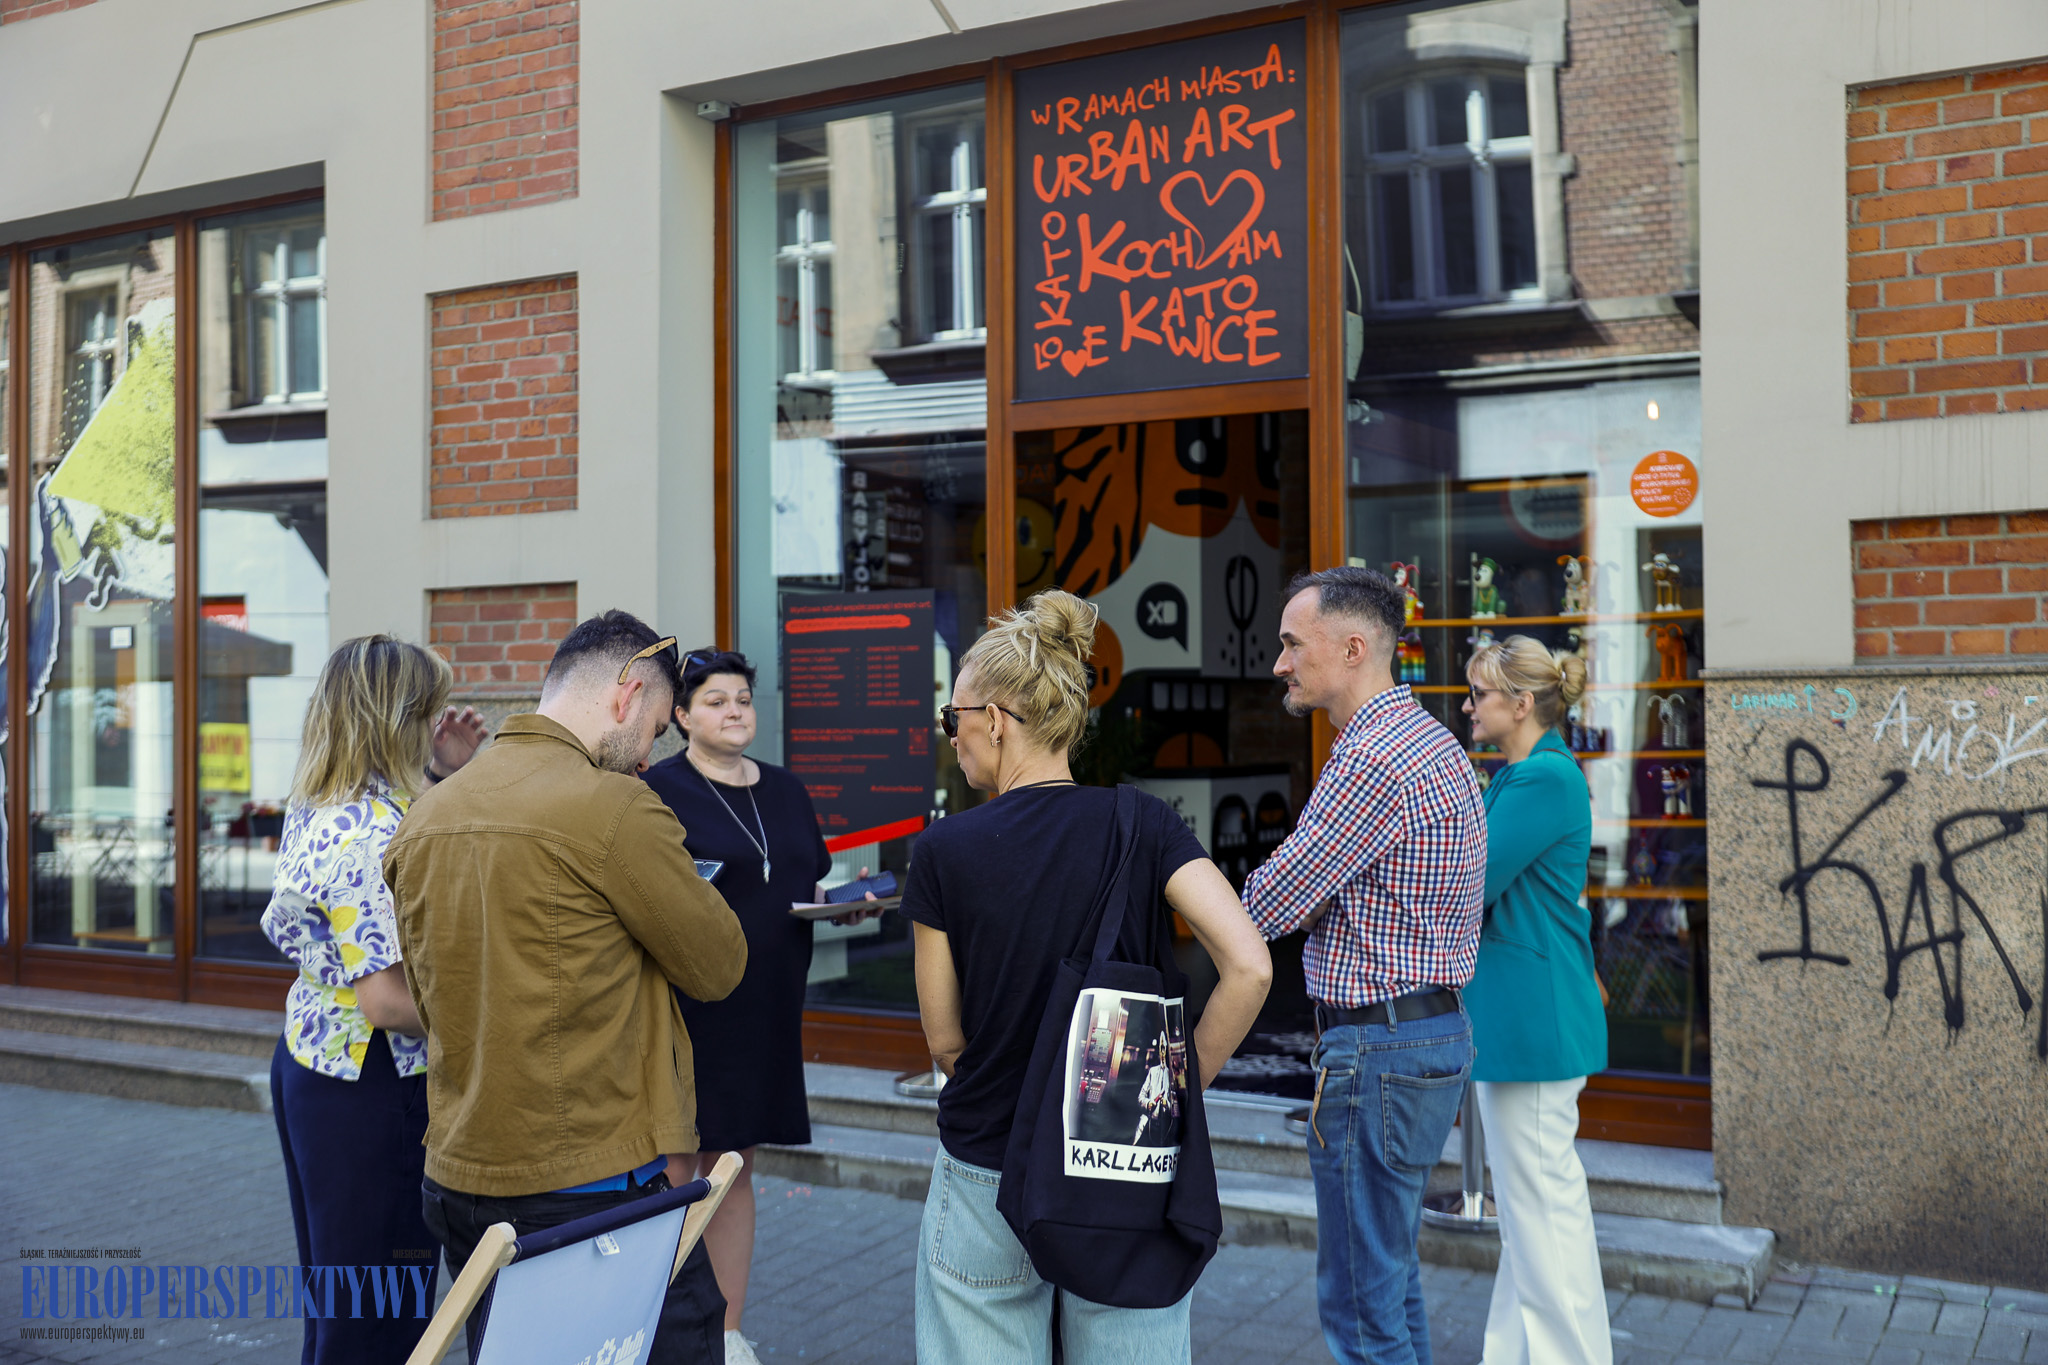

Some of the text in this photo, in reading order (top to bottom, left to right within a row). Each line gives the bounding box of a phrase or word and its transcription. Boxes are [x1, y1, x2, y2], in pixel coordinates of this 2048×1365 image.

[1056, 76, 1170, 135] RAMACH
[1033, 104, 1296, 203] URBAN ART
[1120, 274, 1258, 352] KATO
[1165, 309, 1282, 366] WICE
[1072, 1145, 1124, 1171] KARL
